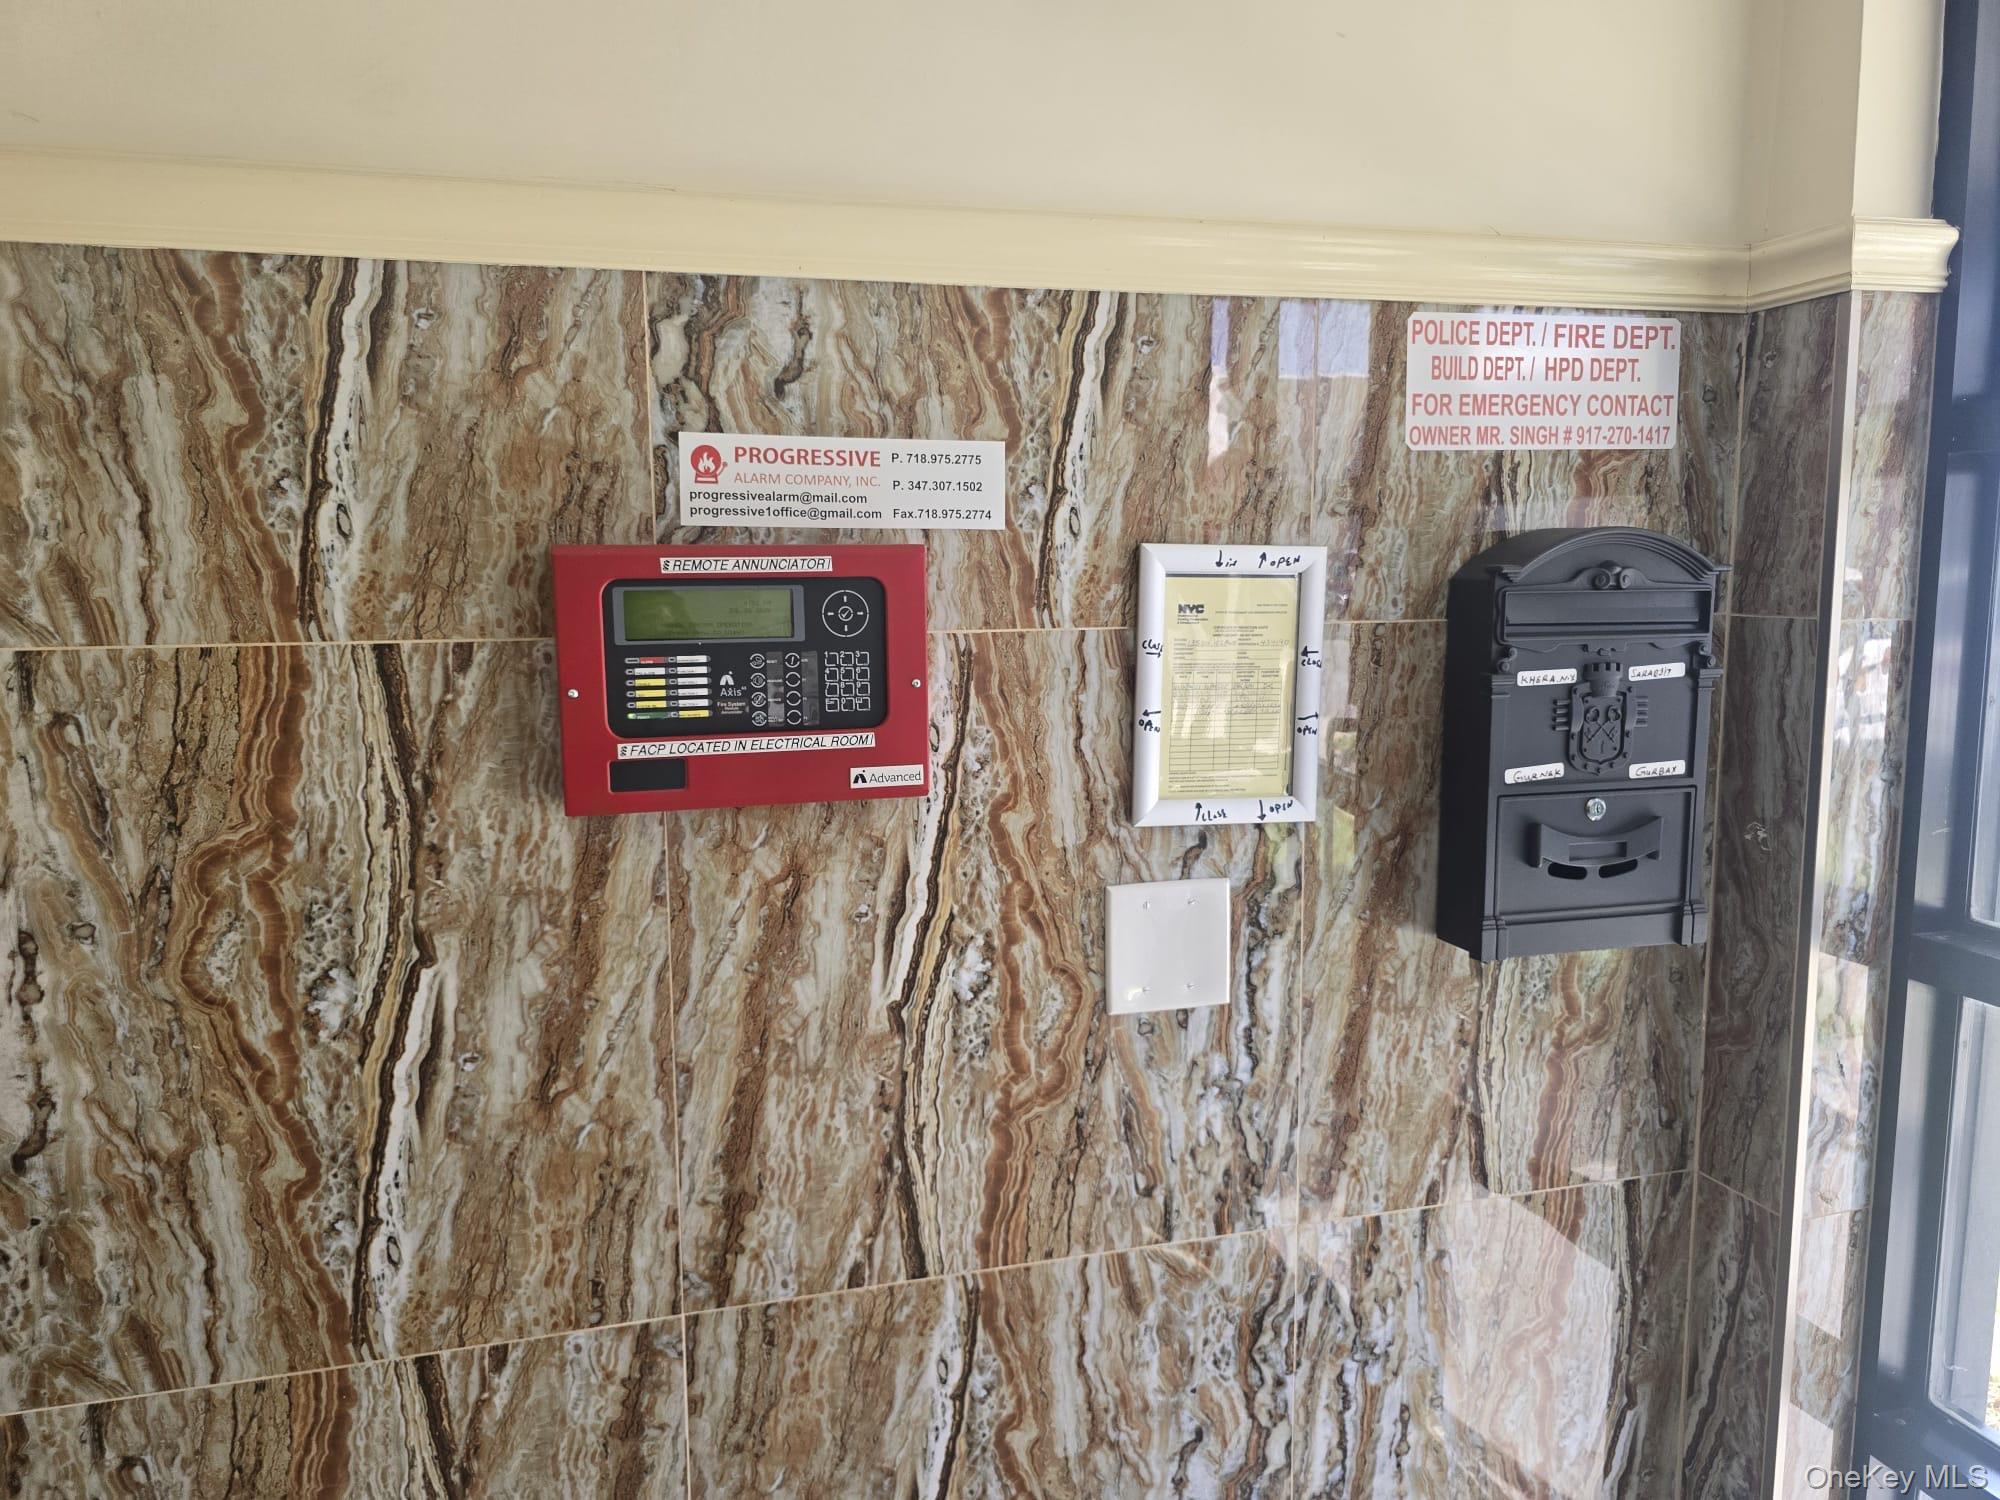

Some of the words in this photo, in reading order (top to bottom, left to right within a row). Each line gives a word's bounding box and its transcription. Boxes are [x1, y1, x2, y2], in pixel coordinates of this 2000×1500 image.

[1412, 320, 1480, 346] POLICE
[1486, 321, 1536, 347] DEPT.
[1554, 324, 1605, 349] FIRE
[1613, 325, 1676, 350] DEPT.
[1431, 355, 1478, 381] BUILD
[1483, 356, 1526, 381] DEPT.
[1545, 357, 1584, 382] HPD
[1590, 358, 1641, 382] DEPT.
[1412, 393, 1453, 416] FOR
[1459, 393, 1582, 417] EMERGENCY
[1587, 394, 1674, 417] CONTACT
[1409, 426, 1471, 446] OWNER
[1476, 426, 1504, 445] MR.
[1510, 426, 1559, 445] SINGH
[1576, 426, 1671, 445] 917-270-1417
[733, 446, 881, 468] PROGRESSIVE
[891, 453, 903, 464] P.
[906, 453, 982, 465] 718.975.2775
[733, 472, 782, 486] ALARM
[784, 473, 852, 488] COMPANY,
[856, 475, 881, 487] INC.
[893, 480, 904, 491] P.
[907, 481, 983, 492] 347.307.1502
[689, 490, 868, 505] progressivealarm@mail.com
[689, 505, 883, 521] progressive1office@gmail.com
[893, 508, 993, 521] Fax.718.975.2774
[672, 560, 730, 571] REMOTE
[732, 558, 826, 571] ANNUNCIATOR
[1178, 604, 1205, 614] NYC
[720, 687, 742, 697] Axis
[630, 744, 666, 756] FACP
[669, 740, 731, 754] LOCATED
[734, 741, 747, 751] IN
[751, 737, 828, 750] ELECTRICAL
[831, 735, 868, 746] ROOM
[869, 771, 922, 783] Advanced
